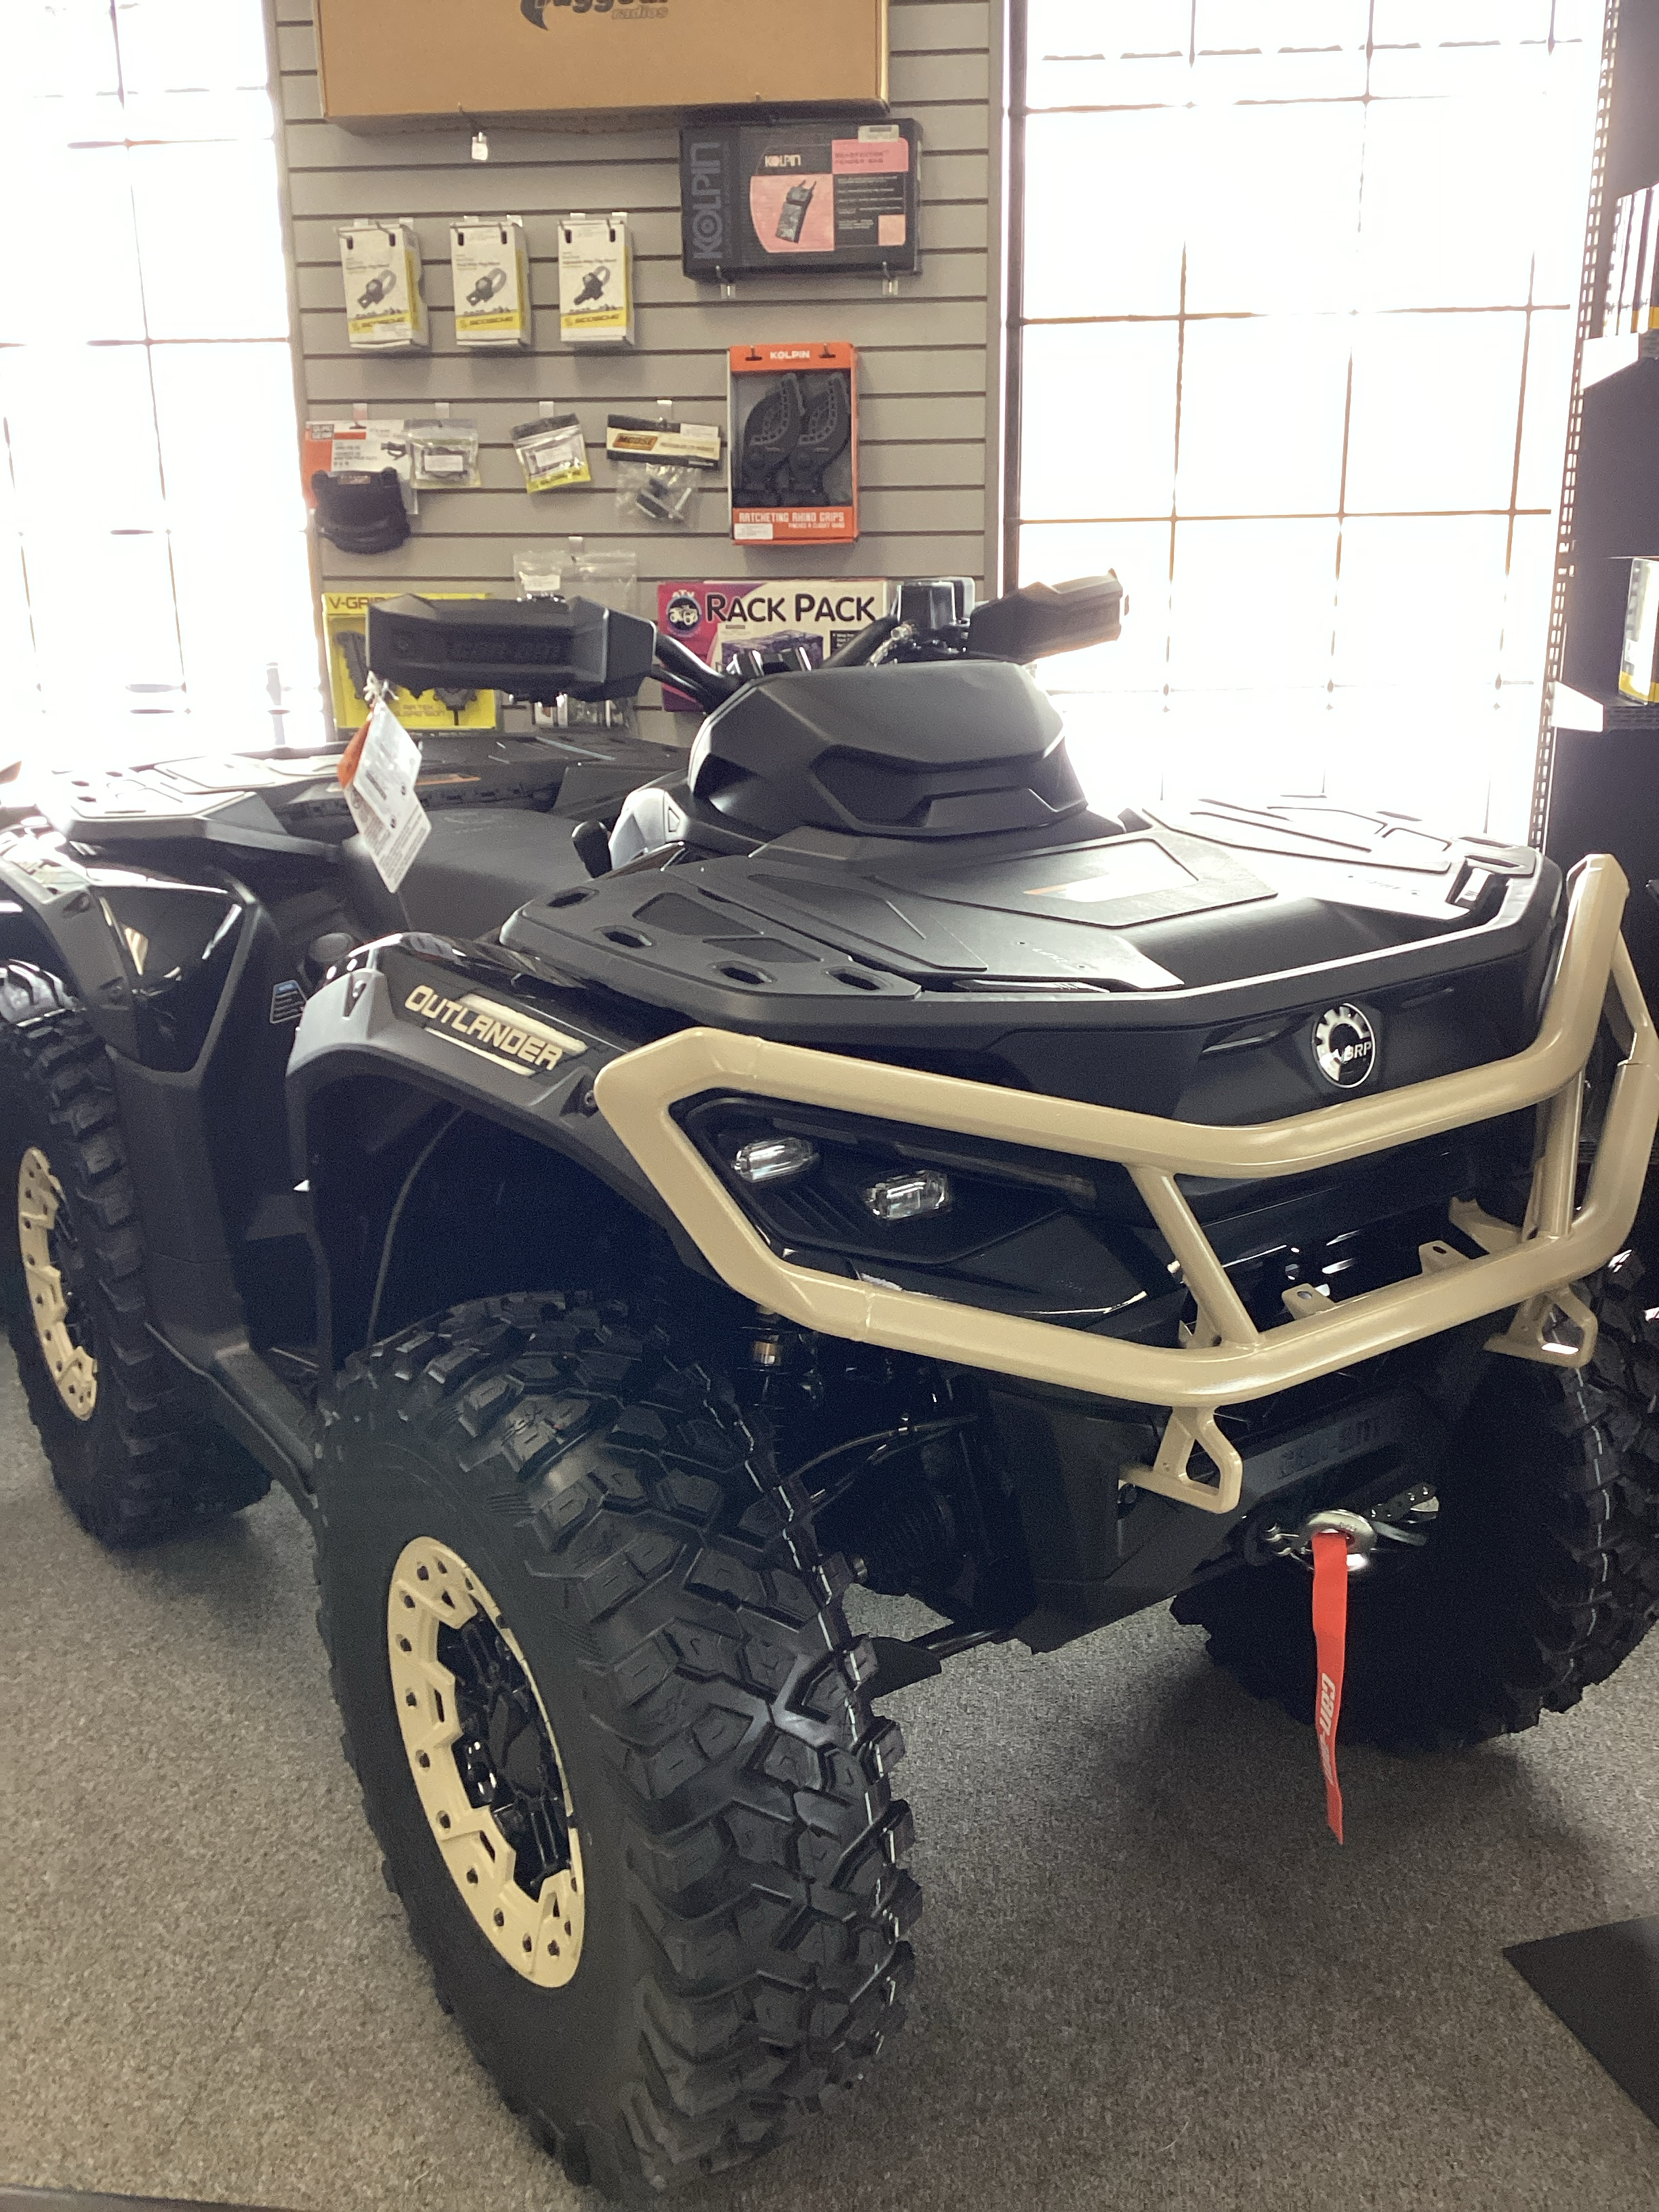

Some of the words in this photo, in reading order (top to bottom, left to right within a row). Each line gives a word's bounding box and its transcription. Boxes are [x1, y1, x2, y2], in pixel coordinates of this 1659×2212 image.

[691, 142, 723, 260] KOLPIN
[770, 350, 810, 360] KOLPIN
[739, 512, 789, 523] RATCHETING
[792, 512, 817, 522] RHINO
[819, 512, 844, 523] GRIPS
[671, 589, 695, 598] ATV
[706, 593, 786, 622] RACK
[794, 593, 876, 622] PACK
[404, 984, 563, 1071] OUTLANDER
[1344, 1041, 1372, 1061] BRP
